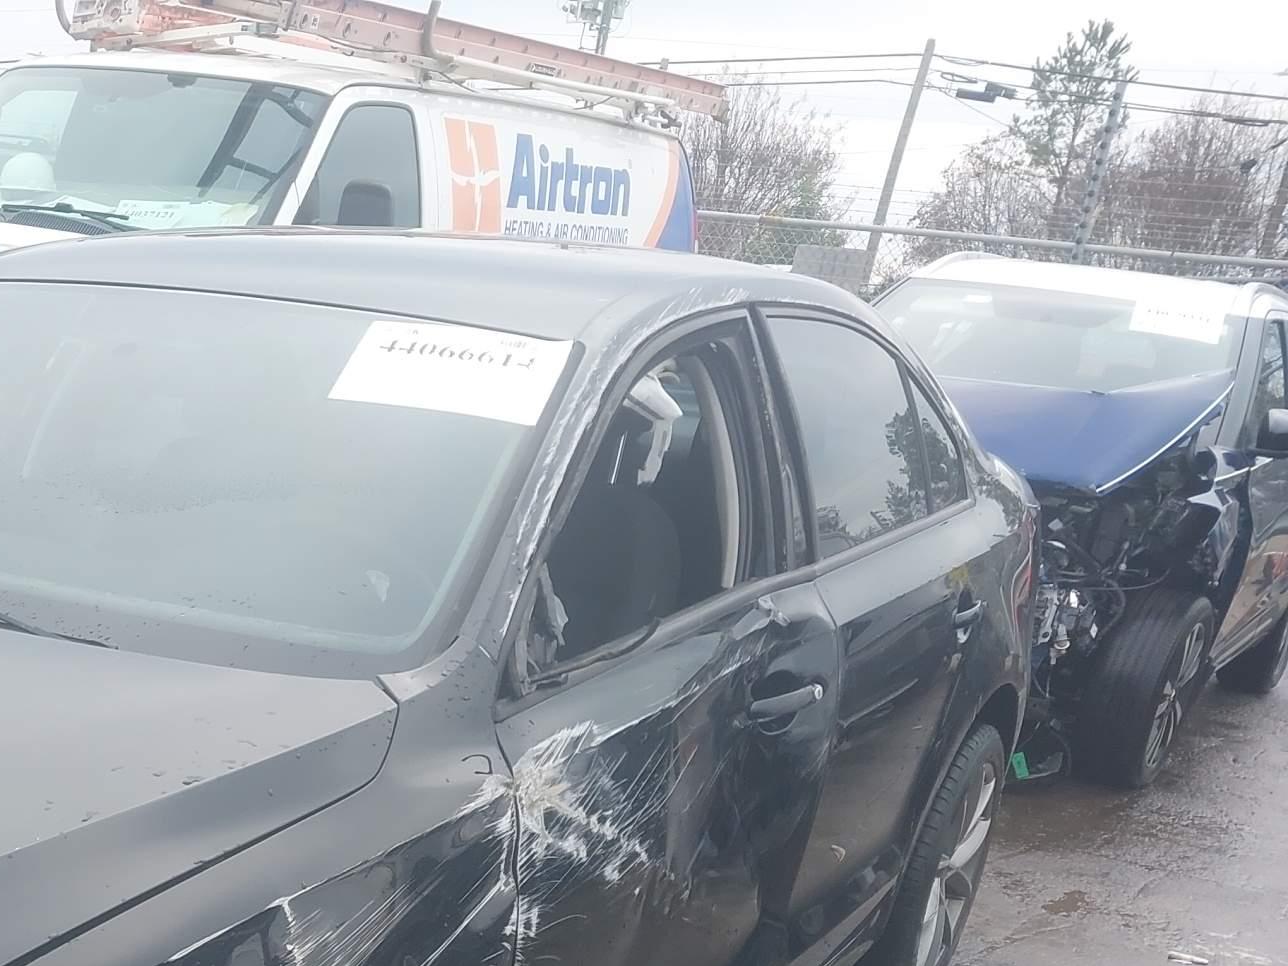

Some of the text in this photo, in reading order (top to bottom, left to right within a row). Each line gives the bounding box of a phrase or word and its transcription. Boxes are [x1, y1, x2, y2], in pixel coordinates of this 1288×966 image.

[506, 133, 631, 217] Airtron
[504, 219, 629, 245] HEATING & AIR CONDITIONING
